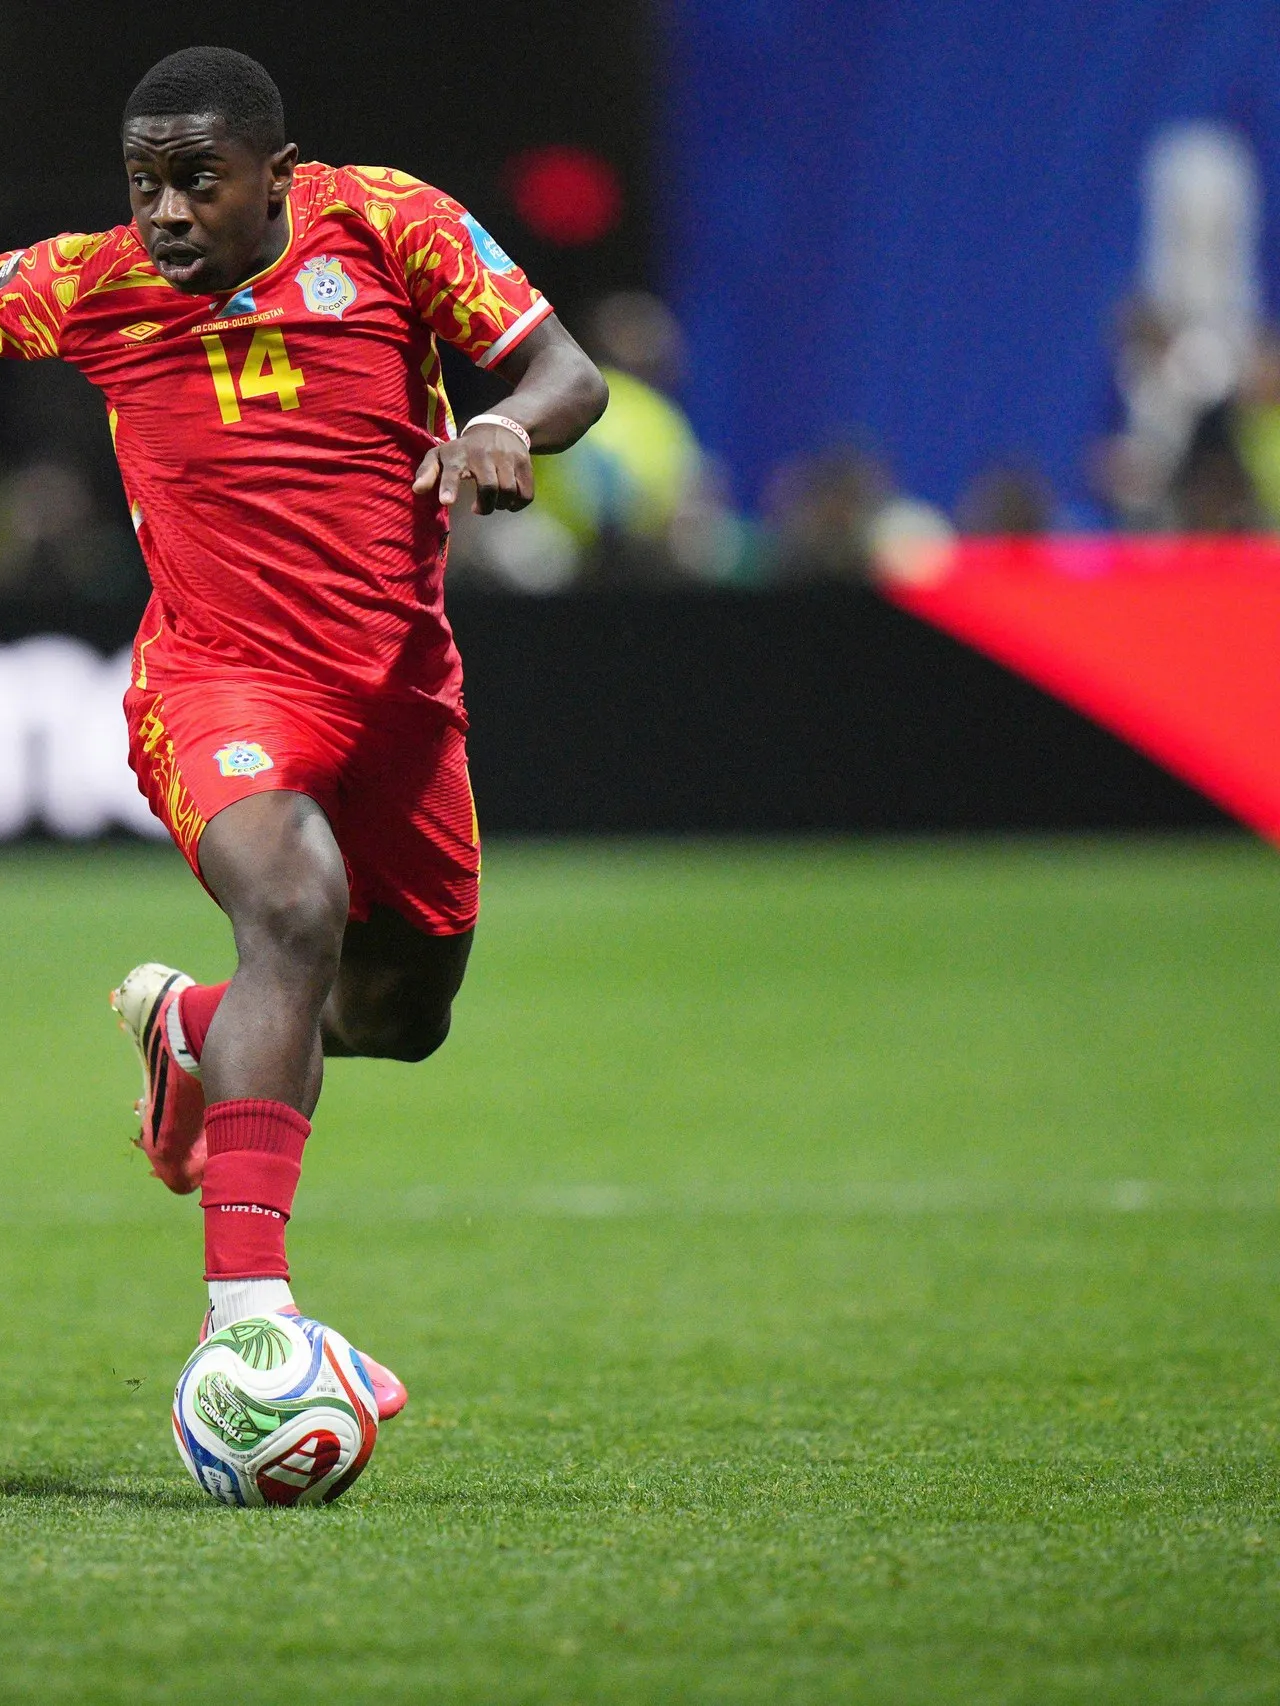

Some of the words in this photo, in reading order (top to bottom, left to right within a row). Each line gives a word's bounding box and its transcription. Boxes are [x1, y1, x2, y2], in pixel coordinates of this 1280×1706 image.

[317, 295, 348, 312] FECOFA
[191, 326, 202, 334] RD
[202, 307, 285, 332] CONGO-OUZBEKISTAN
[200, 326, 306, 425] 14
[221, 1204, 281, 1219] umbro
[200, 1396, 243, 1444] TRIONDA
